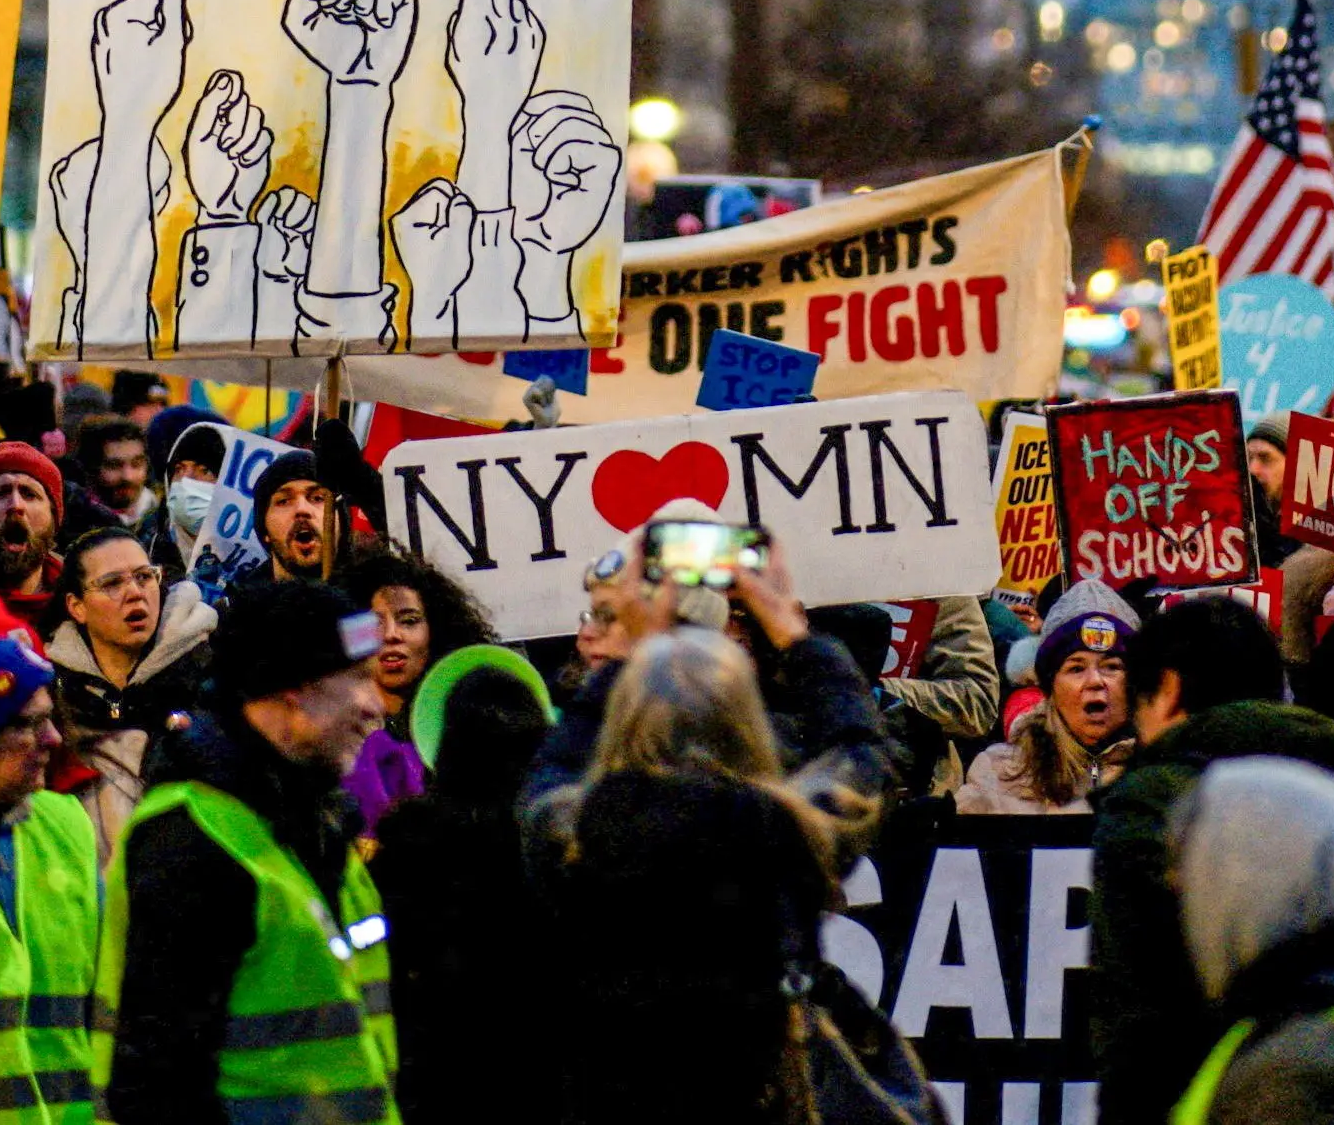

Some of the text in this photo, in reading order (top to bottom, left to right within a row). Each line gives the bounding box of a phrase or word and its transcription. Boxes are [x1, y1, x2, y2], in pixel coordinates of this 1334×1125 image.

[623, 216, 959, 299] RKER RIGHTS
[808, 275, 1008, 363] FIGHT
[718, 342, 802, 378] STOP
[1246, 342, 1278, 375] 4
[1014, 439, 1048, 472] ICE
[1080, 427, 1222, 482] HANDS
[394, 416, 959, 571] NY MN
[1008, 474, 1054, 505] OUT
[1104, 480, 1191, 524] OFF
[1000, 540, 1060, 583] YORK
[1076, 509, 1245, 580] SCHOOLS
